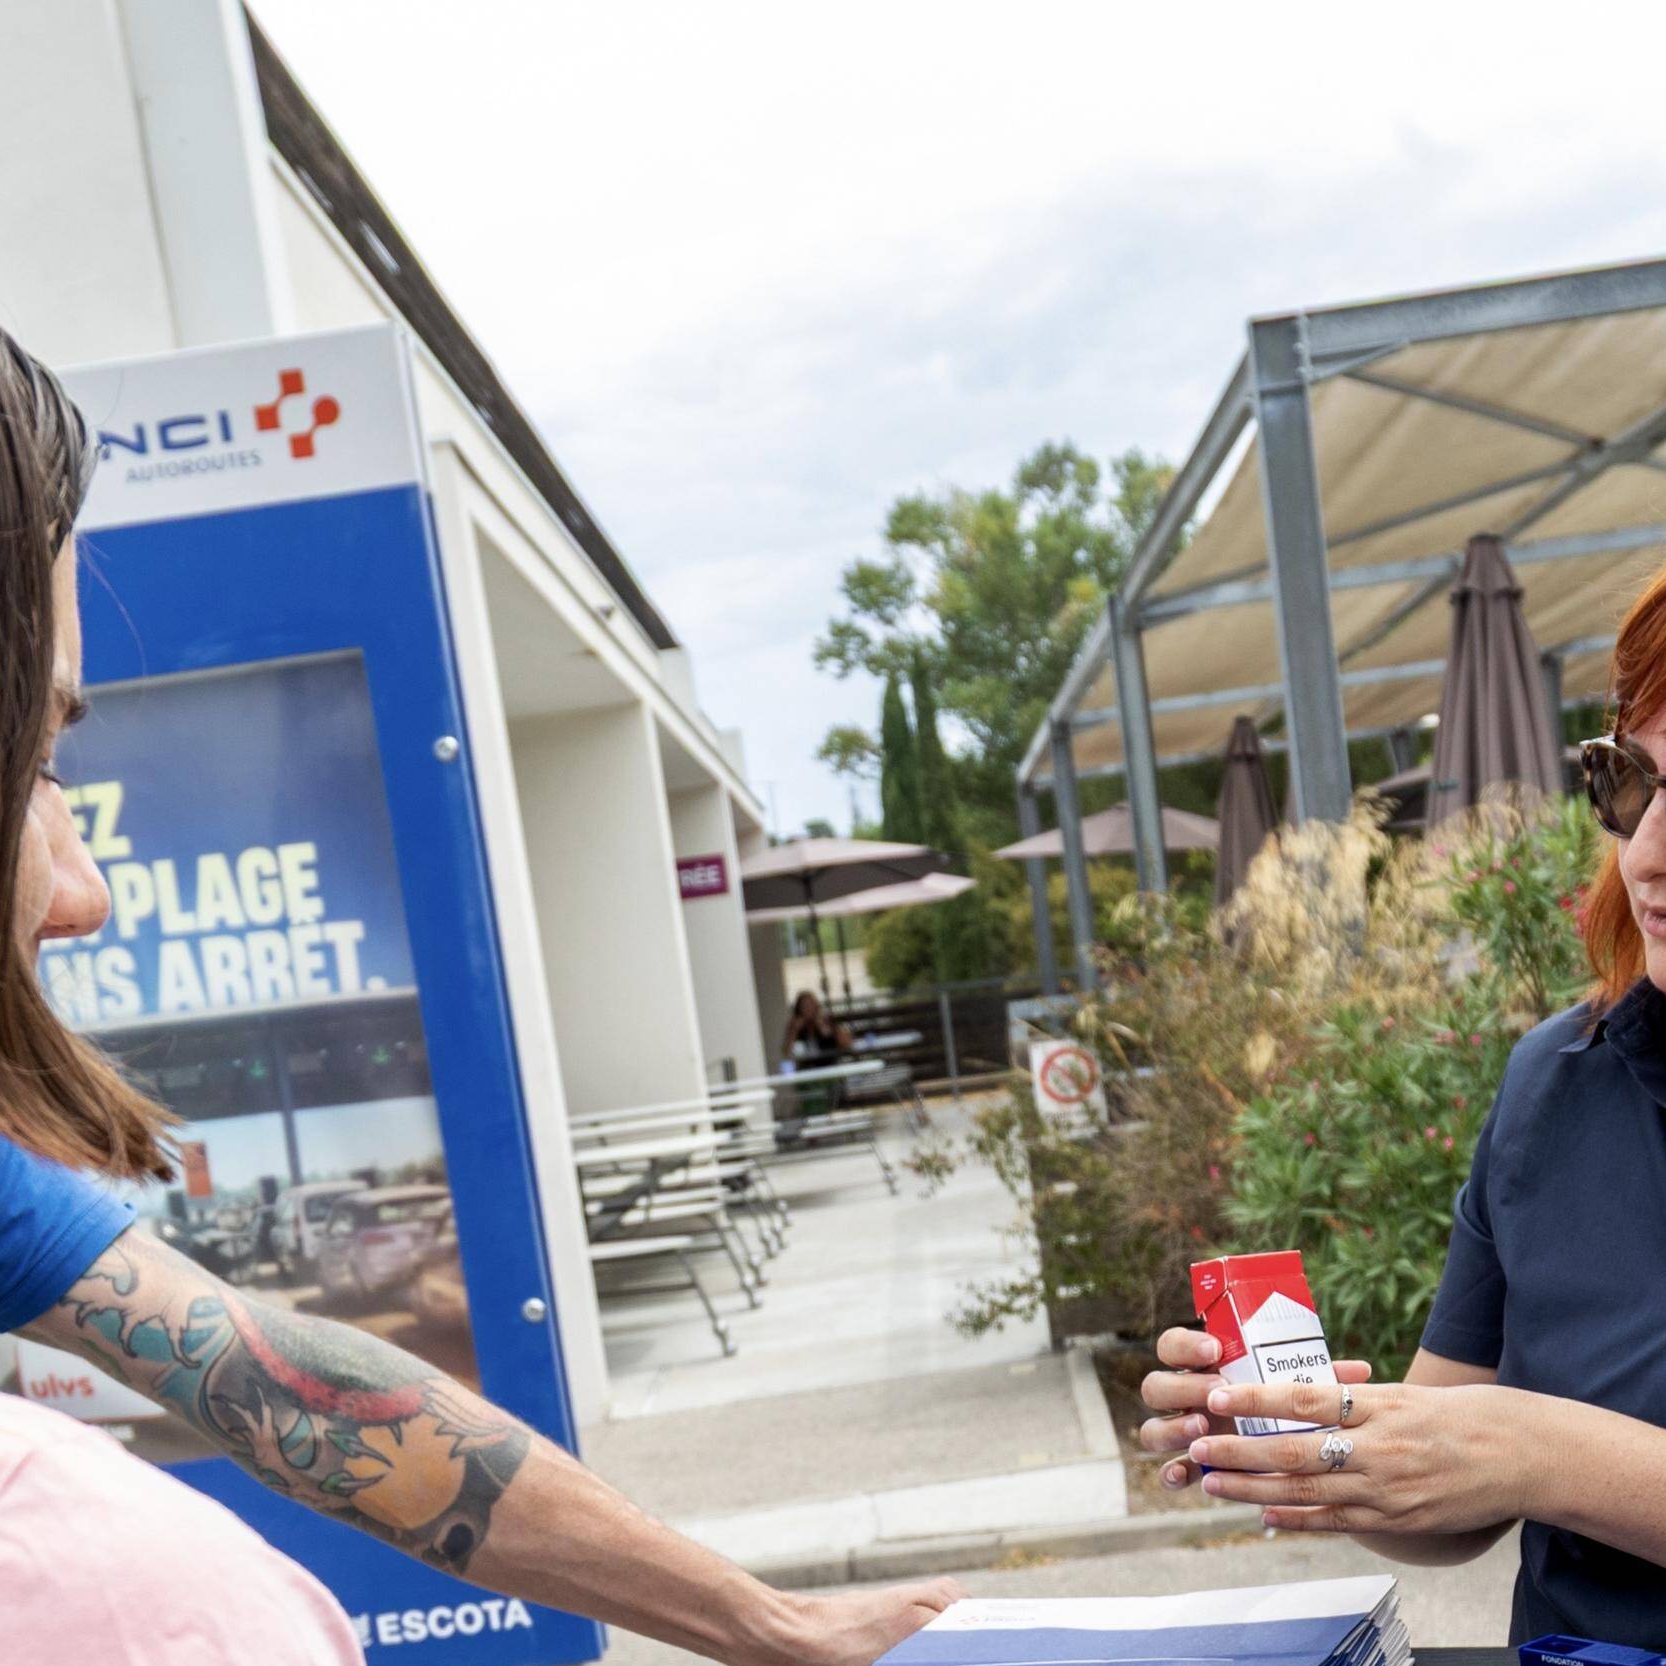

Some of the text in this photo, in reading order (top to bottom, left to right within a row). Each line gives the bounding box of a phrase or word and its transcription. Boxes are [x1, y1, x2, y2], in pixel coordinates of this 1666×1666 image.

[97, 409, 232, 461] NCI
[125, 450, 263, 484] AUTOROUTES
[108, 842, 324, 939] PLAGE
[679, 863, 721, 888] RÉE
[1266, 1352, 1328, 1373] Smokers
[376, 1597, 533, 1645] ESCOTA
